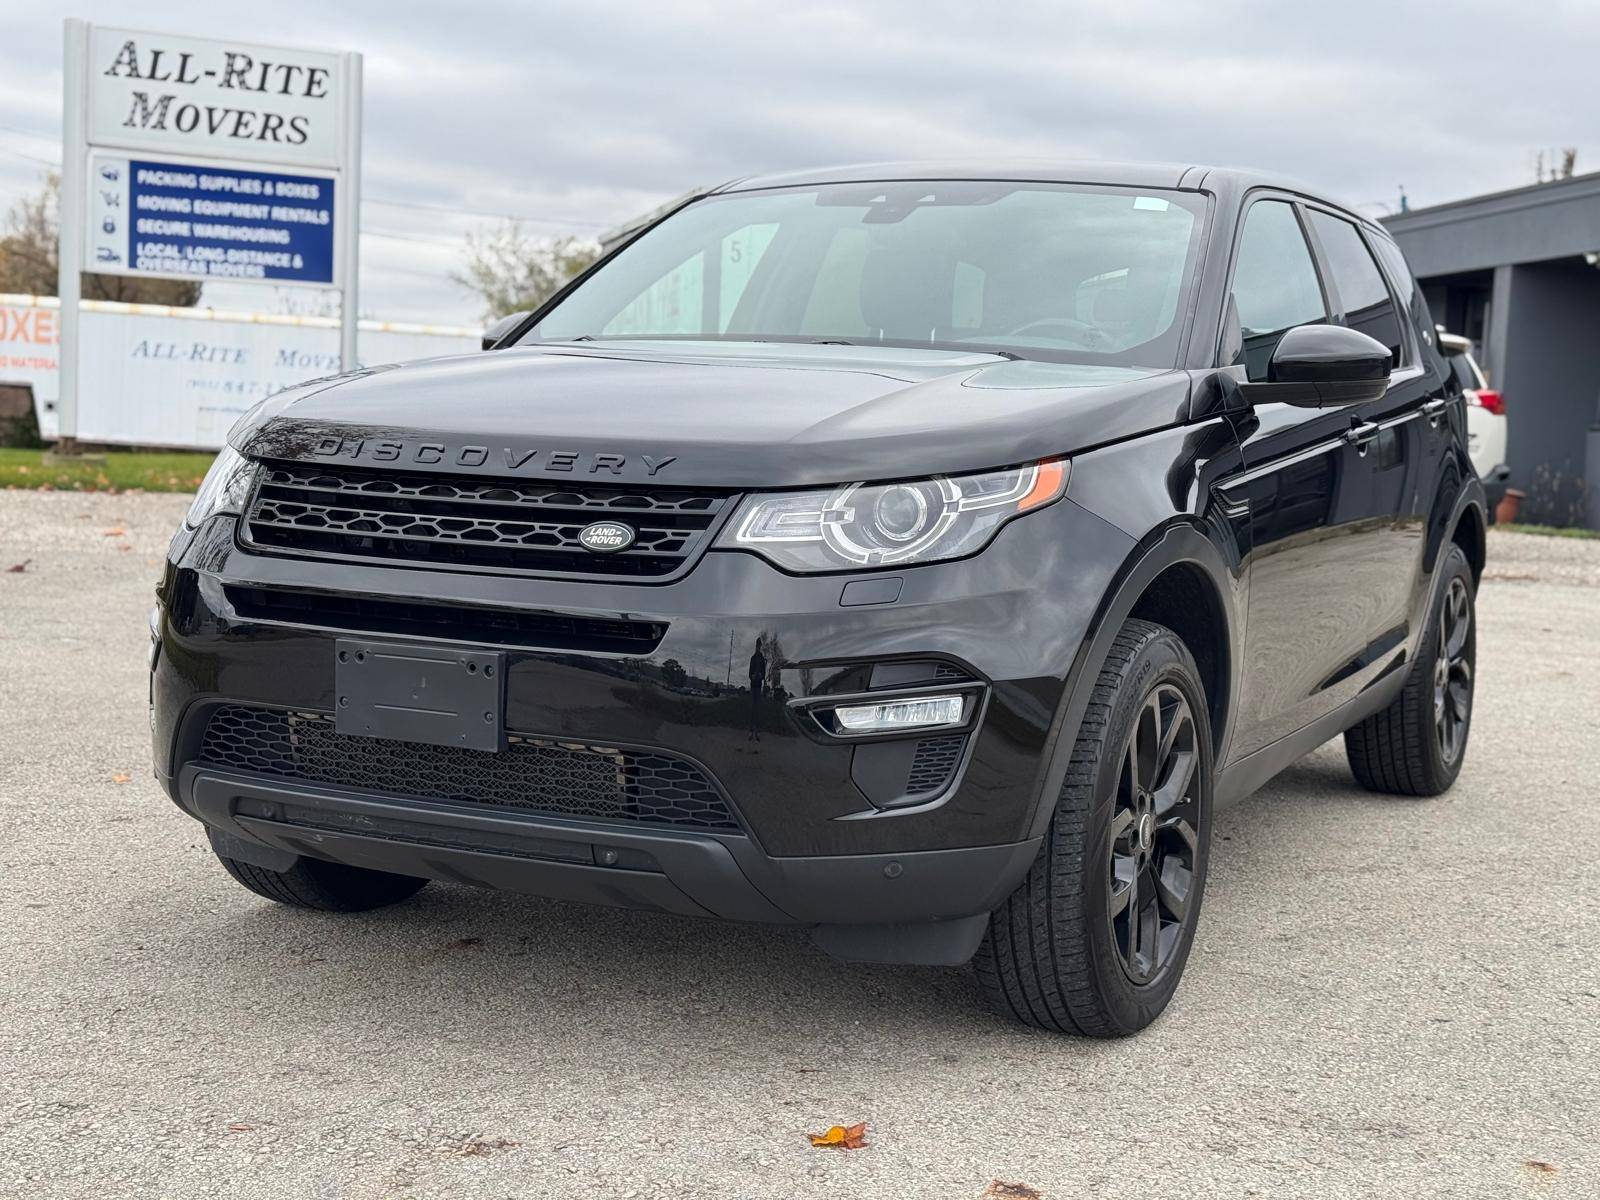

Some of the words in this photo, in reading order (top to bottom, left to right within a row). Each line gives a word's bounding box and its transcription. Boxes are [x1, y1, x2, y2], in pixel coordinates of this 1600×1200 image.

[104, 40, 330, 98] ALL-RITE
[122, 92, 310, 145] MOVERS
[137, 169, 198, 188] PACKING
[199, 174, 262, 195] SUPPLIES
[263, 181, 274, 196] &
[275, 182, 320, 200] BOXES
[137, 194, 192, 213] MOVING
[193, 199, 270, 220] EQUIPMENT
[271, 206, 330, 225] RENTALS
[137, 218, 191, 237] SECURE
[192, 223, 290, 244] WAREHOUSING
[209, 262, 266, 278] MOVERS
[292, 253, 303, 269] &
[0, 308, 61, 344] OXE
[130, 340, 249, 363] ALL-RITE
[274, 350, 364, 369] MOVE
[313, 437, 677, 476] DISCOVERY
[589, 527, 616, 536] LAND
[589, 535, 622, 545] ROVER
